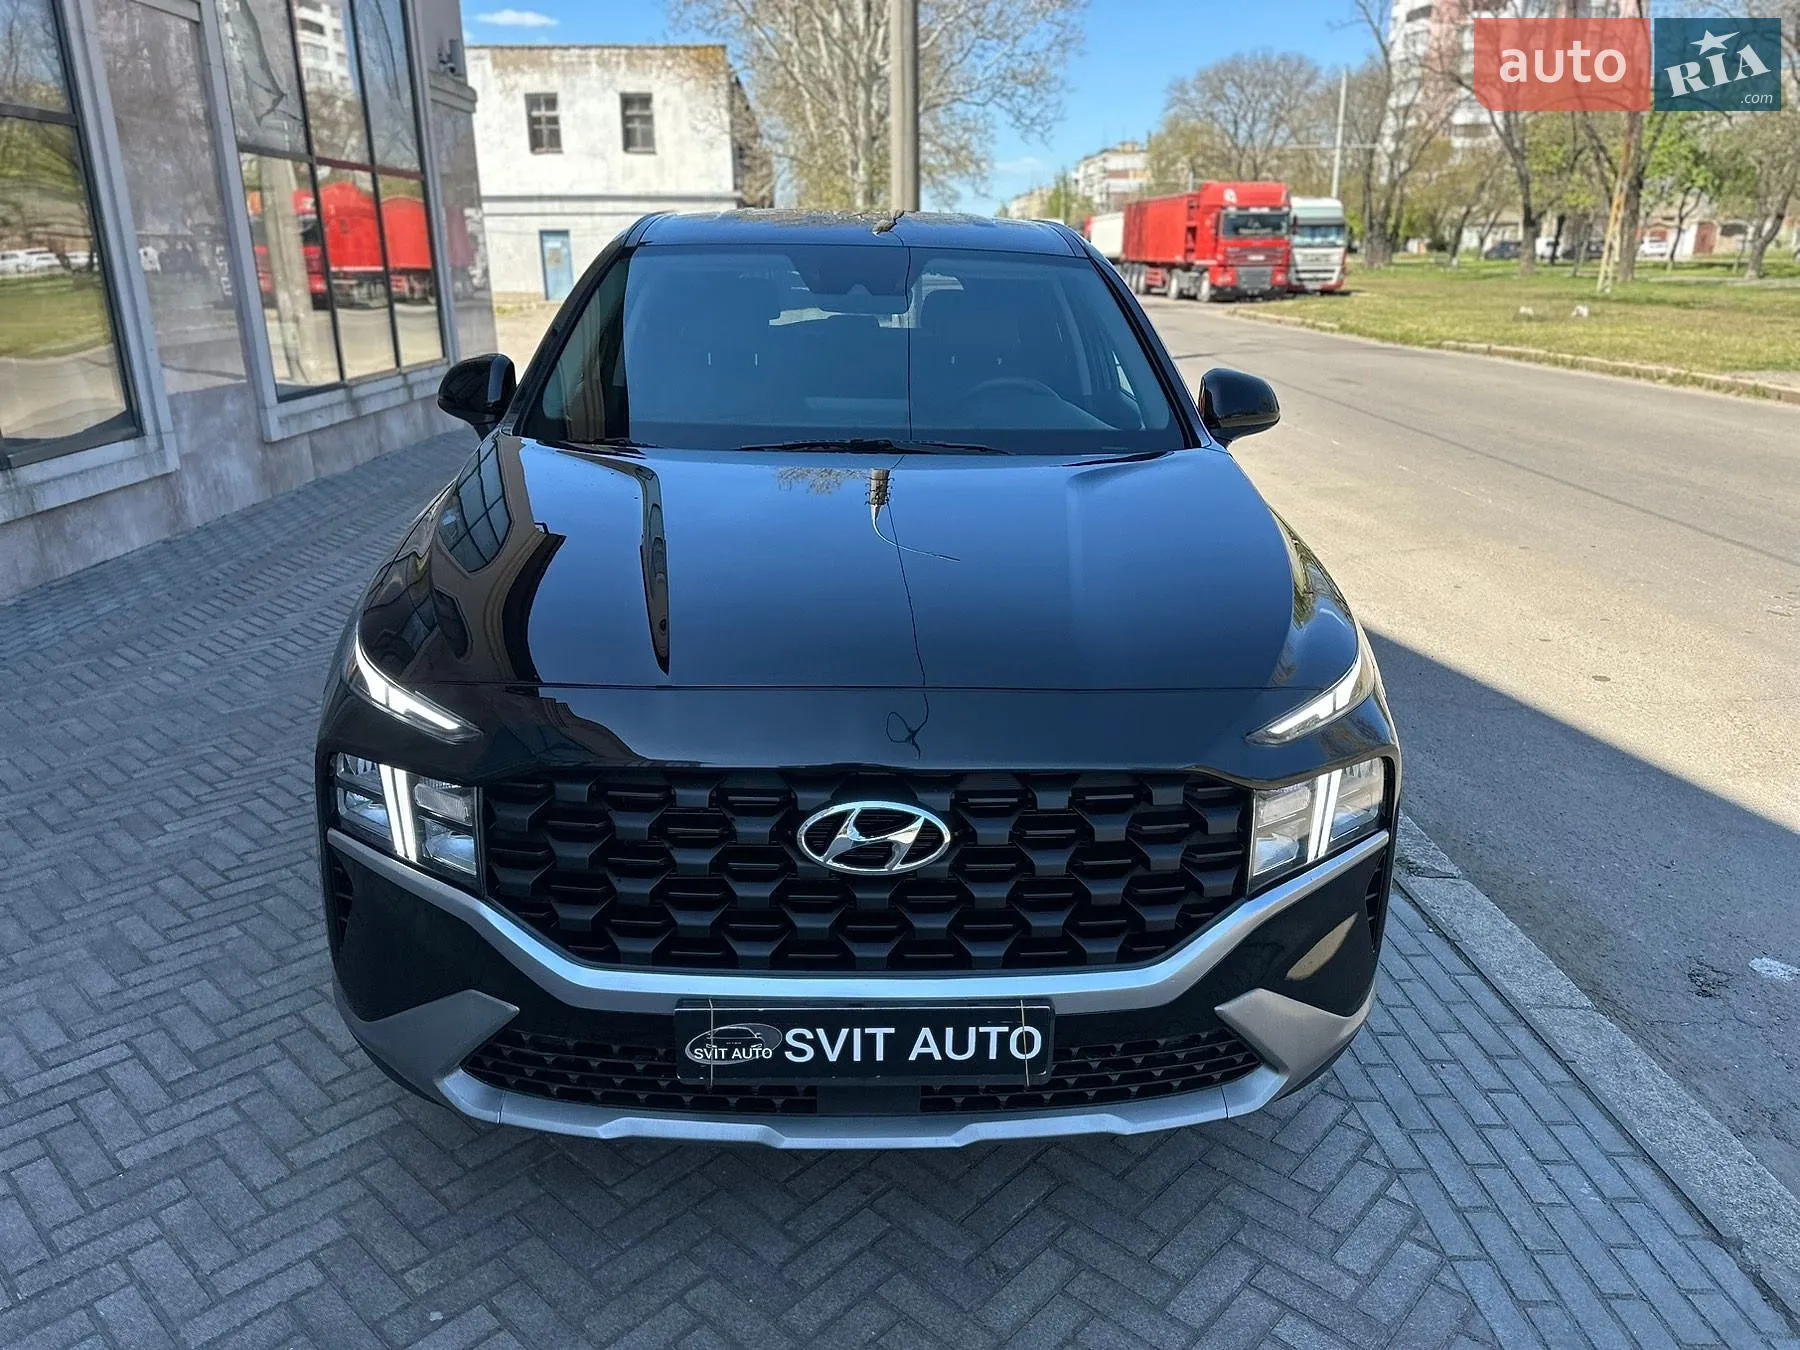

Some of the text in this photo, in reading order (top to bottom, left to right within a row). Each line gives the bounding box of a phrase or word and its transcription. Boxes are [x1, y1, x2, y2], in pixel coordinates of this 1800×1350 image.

[693, 1047, 773, 1060] SVIT AUTO
[784, 1026, 1042, 1063] SVIT AUTO
